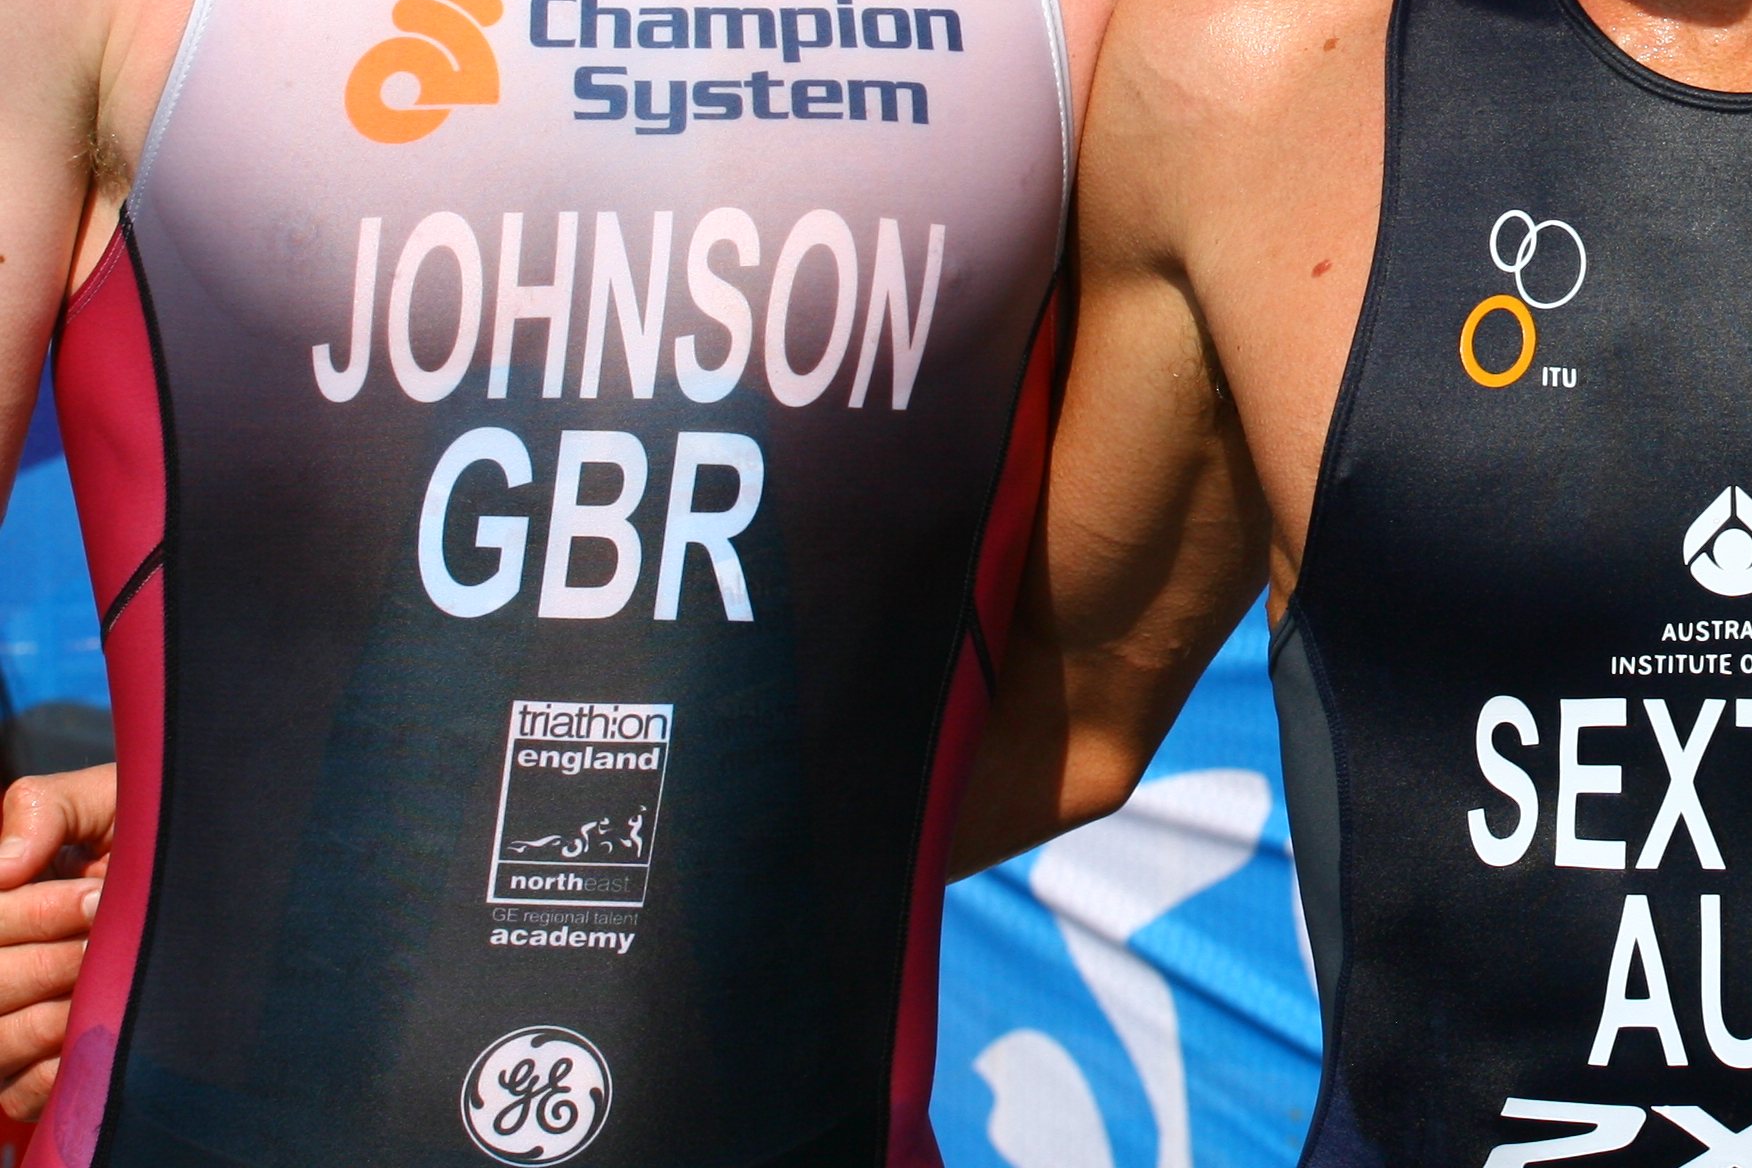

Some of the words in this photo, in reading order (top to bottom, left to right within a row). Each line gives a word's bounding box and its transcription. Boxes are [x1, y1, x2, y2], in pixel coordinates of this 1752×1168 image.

[573, 66, 929, 135] System
[312, 207, 946, 410] JOHNSON
[1541, 366, 1577, 389] ITU
[418, 426, 764, 622] GBR
[1611, 653, 1733, 676] INSTITUTE
[517, 746, 660, 775] england
[492, 907, 519, 922] GE
[523, 910, 590, 926] regional
[593, 911, 639, 926] talent
[489, 925, 636, 954] academy
